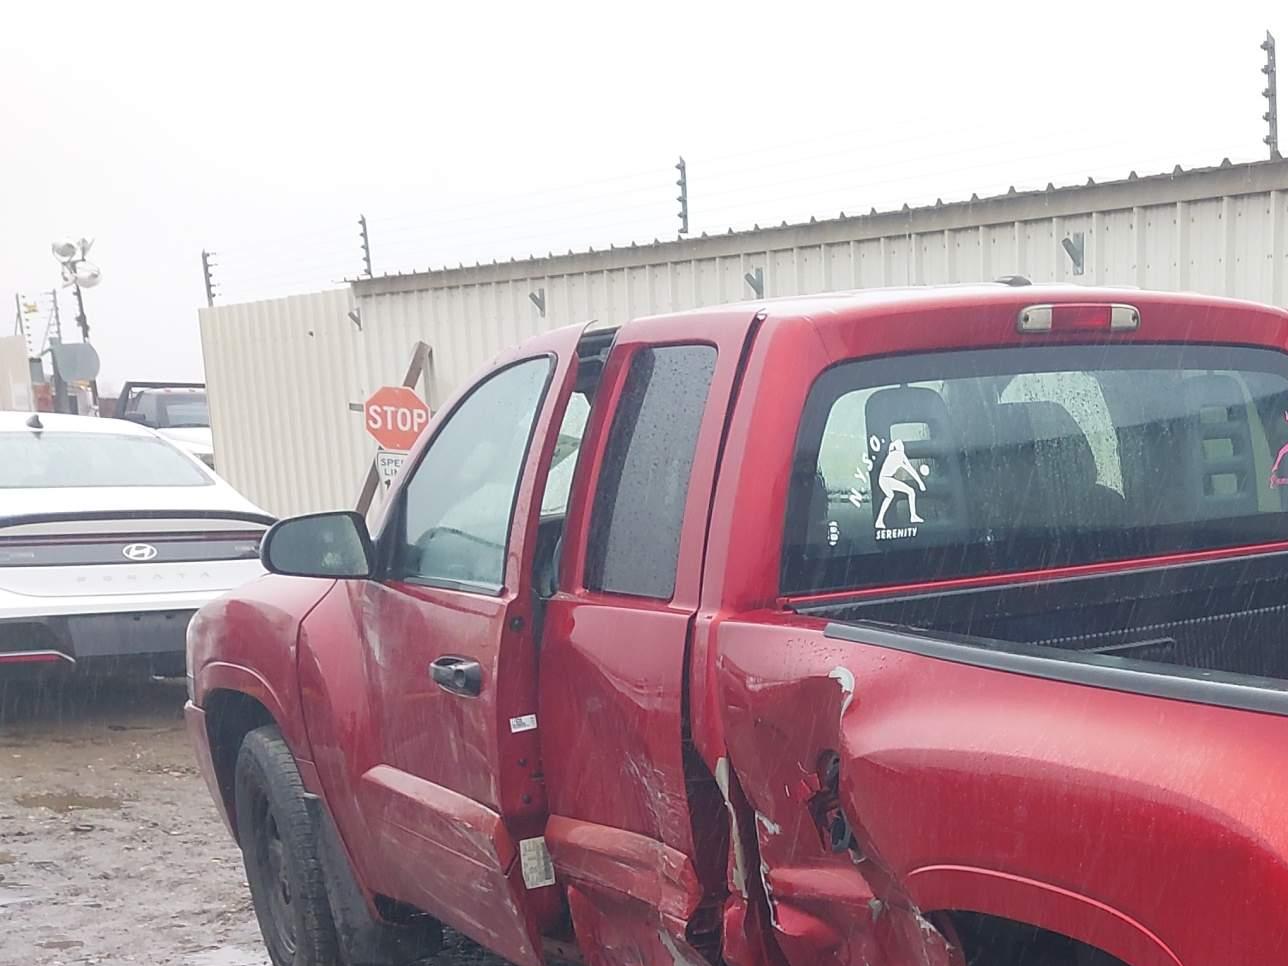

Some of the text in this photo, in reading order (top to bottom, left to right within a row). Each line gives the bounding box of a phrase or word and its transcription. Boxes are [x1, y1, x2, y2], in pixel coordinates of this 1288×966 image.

[368, 405, 426, 432] STOP
[380, 458, 404, 468] SPE
[876, 527, 917, 540] SERENITY
